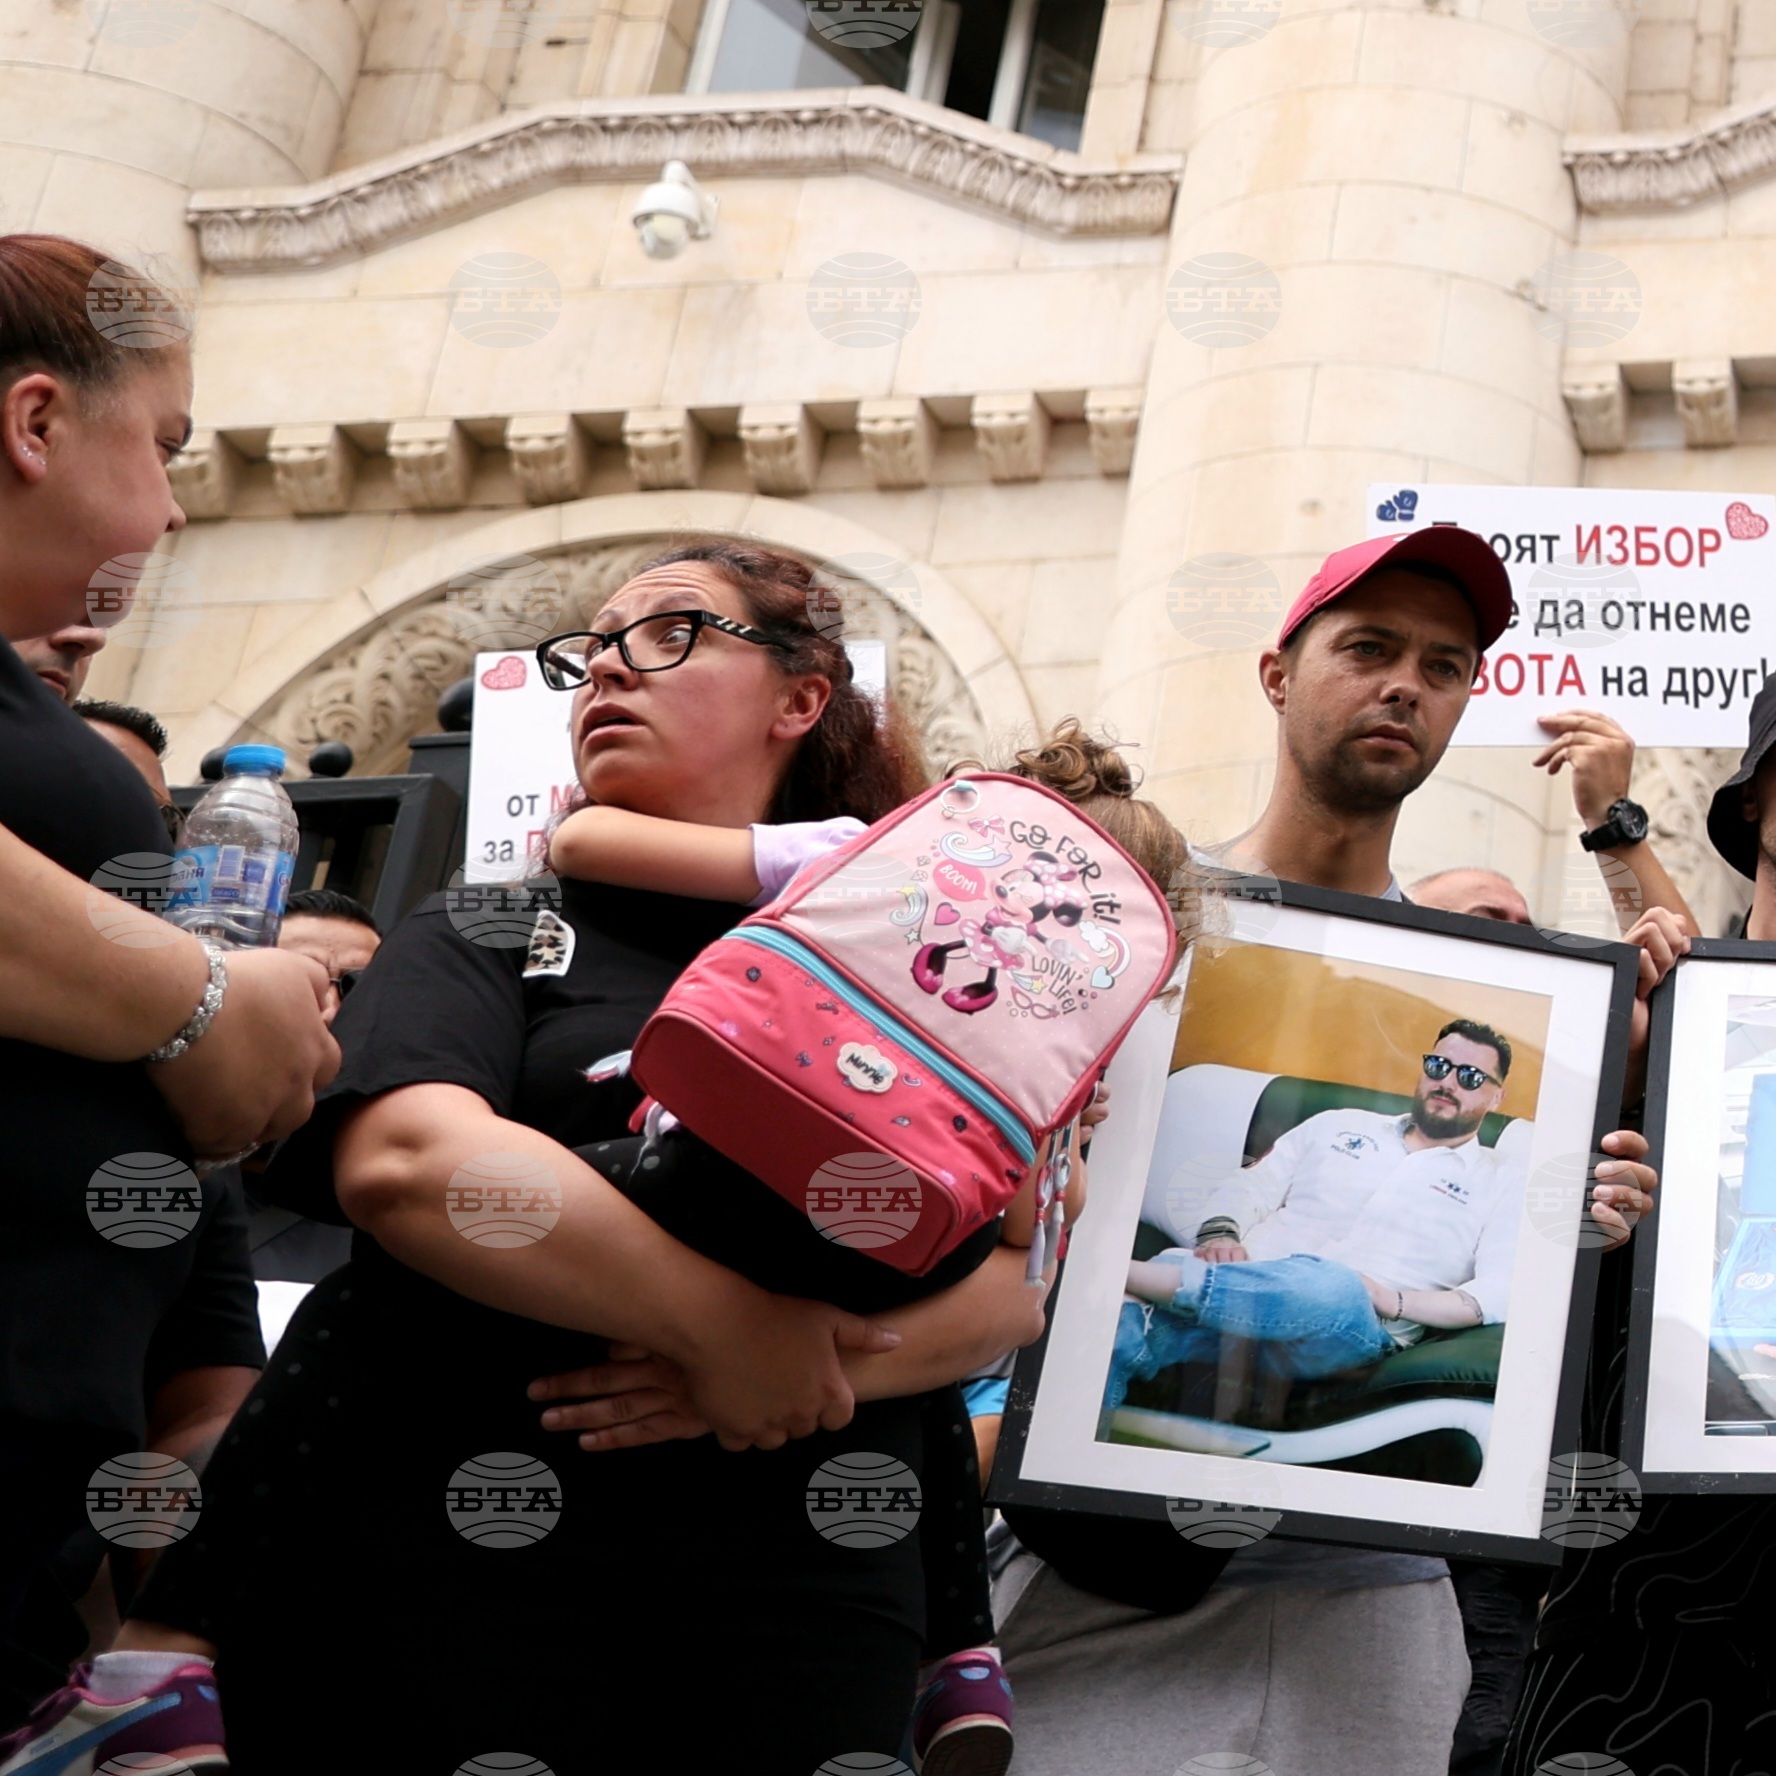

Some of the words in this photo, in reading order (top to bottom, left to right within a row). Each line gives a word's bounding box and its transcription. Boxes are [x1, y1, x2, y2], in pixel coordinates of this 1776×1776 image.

[1575, 524, 1722, 568] ИЗБОР
[1534, 598, 1585, 637] да
[1600, 598, 1751, 634] отнеме
[1602, 664, 1648, 698] на
[507, 794, 541, 817] от
[483, 839, 514, 863] за
[1009, 820, 1052, 850] GO
[1055, 835, 1102, 893] FOR
[939, 864, 978, 894] BOOM!
[846, 1053, 884, 1085] Minnie
